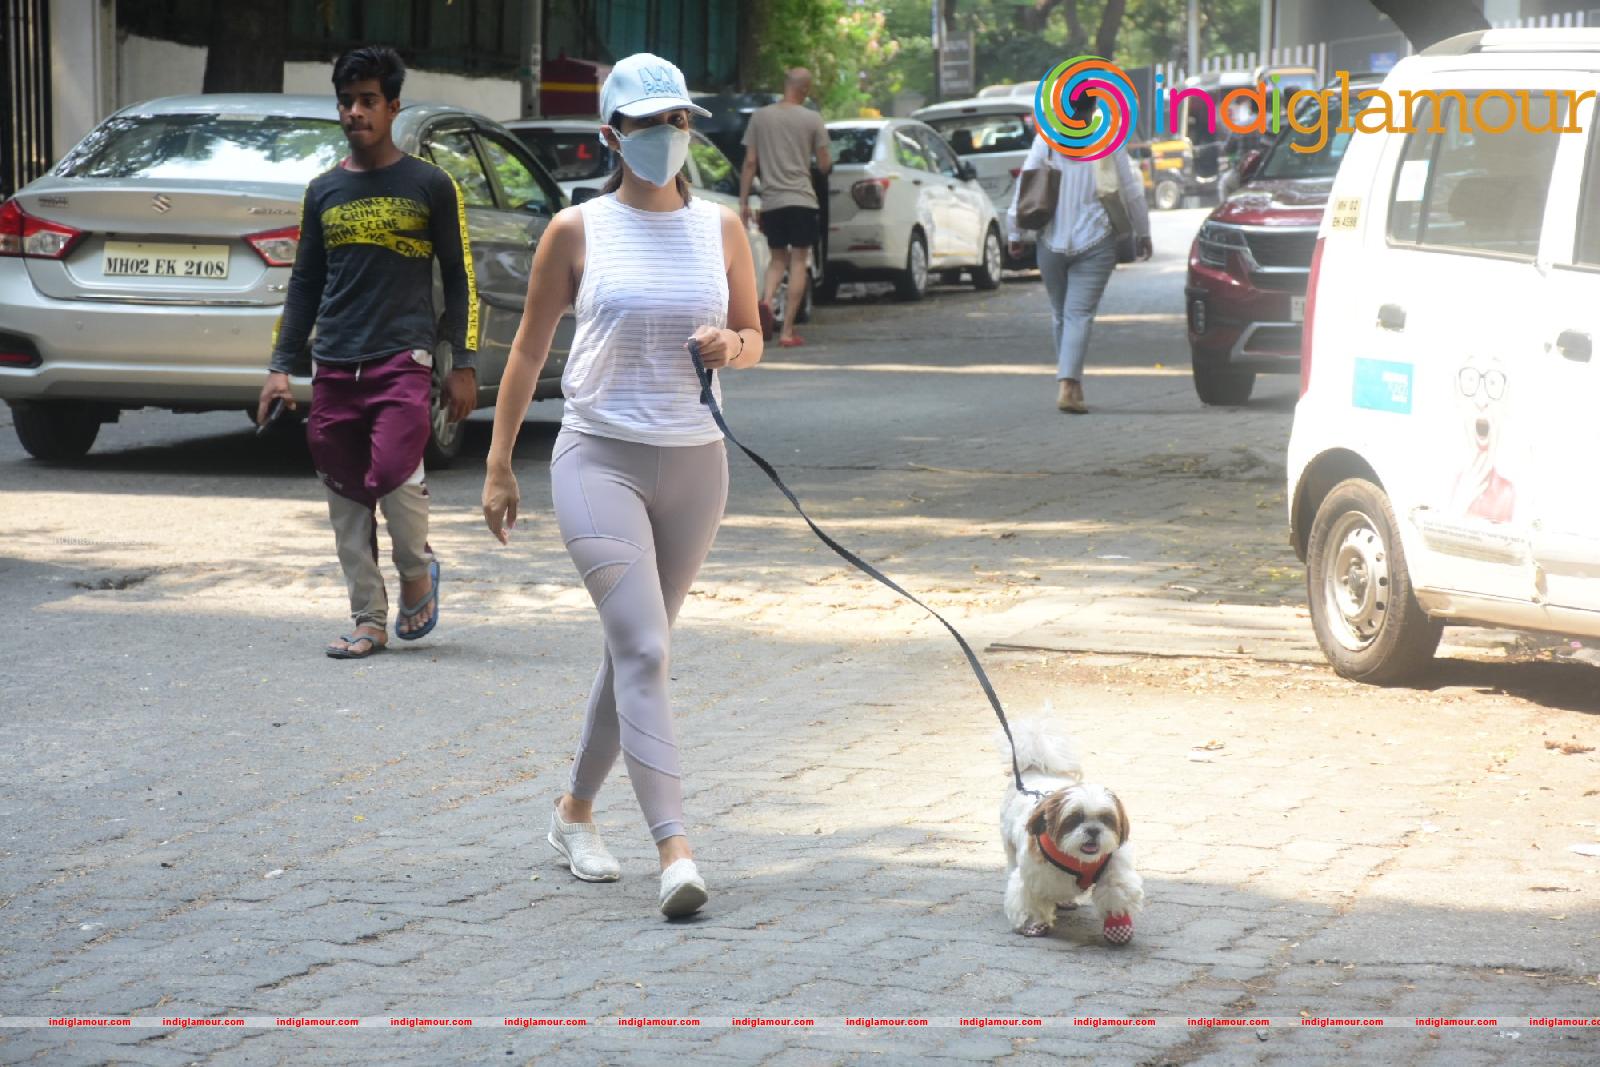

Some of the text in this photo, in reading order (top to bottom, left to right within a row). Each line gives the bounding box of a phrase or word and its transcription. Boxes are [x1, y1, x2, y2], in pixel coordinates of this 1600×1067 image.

[340, 208, 382, 221] CRIME
[360, 218, 400, 232] SCENE
[106, 257, 149, 274] MH02
[184, 260, 225, 276] 2108
